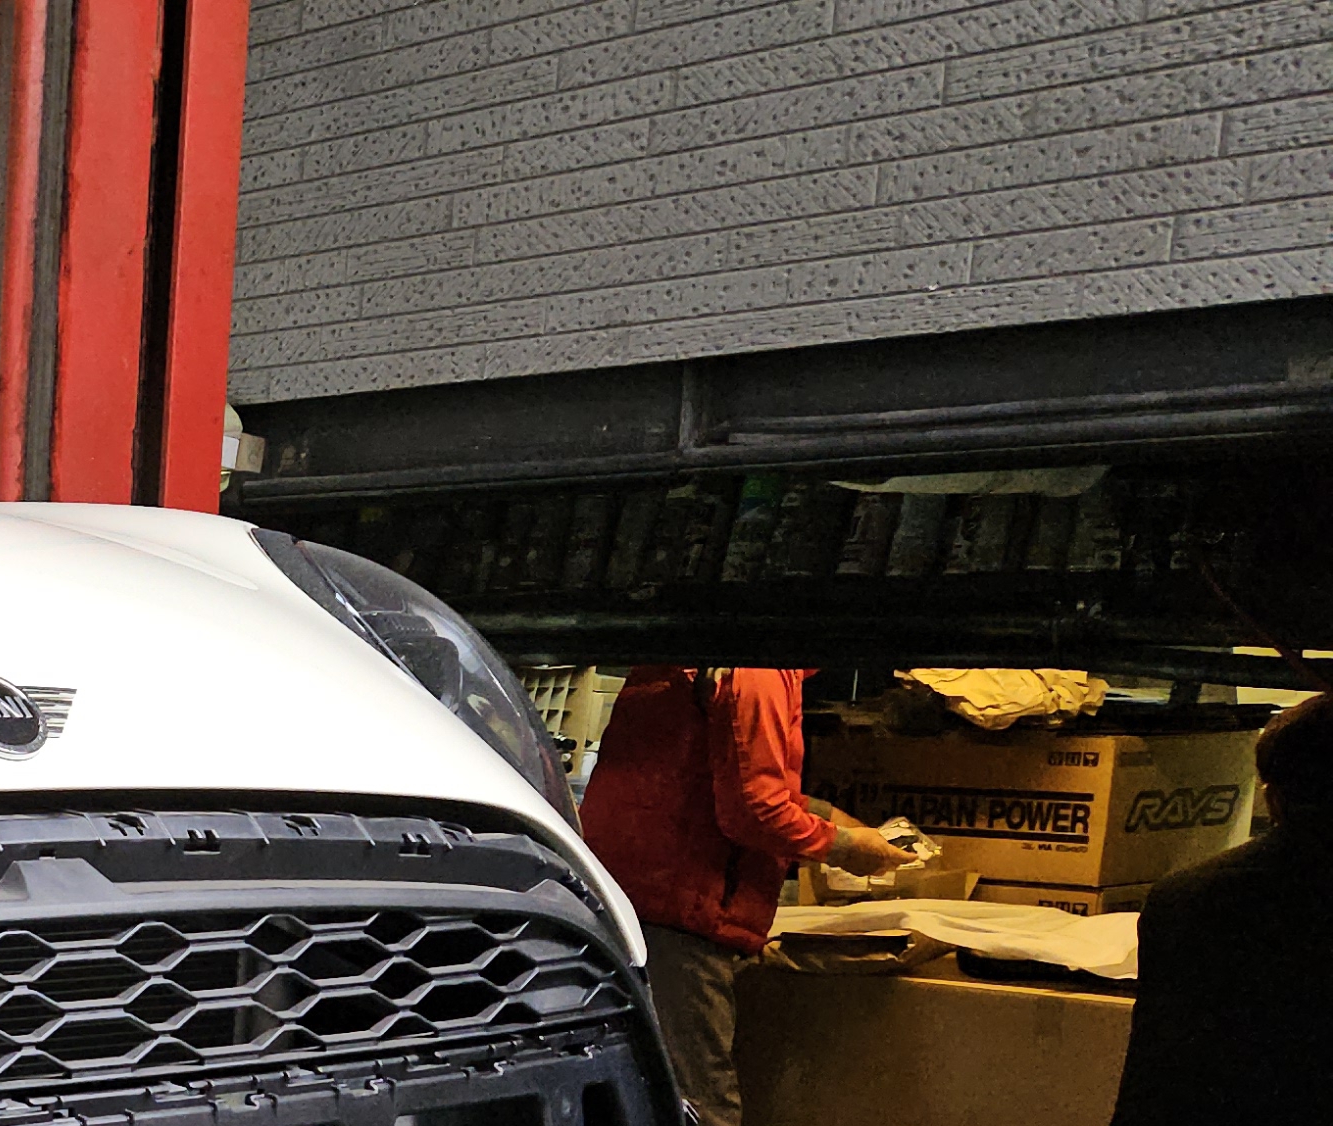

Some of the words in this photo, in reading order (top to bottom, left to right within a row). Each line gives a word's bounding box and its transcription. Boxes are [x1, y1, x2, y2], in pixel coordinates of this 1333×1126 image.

[882, 791, 977, 828] JAPAN
[986, 800, 1092, 835] POWER
[1124, 784, 1241, 834] RAYS
